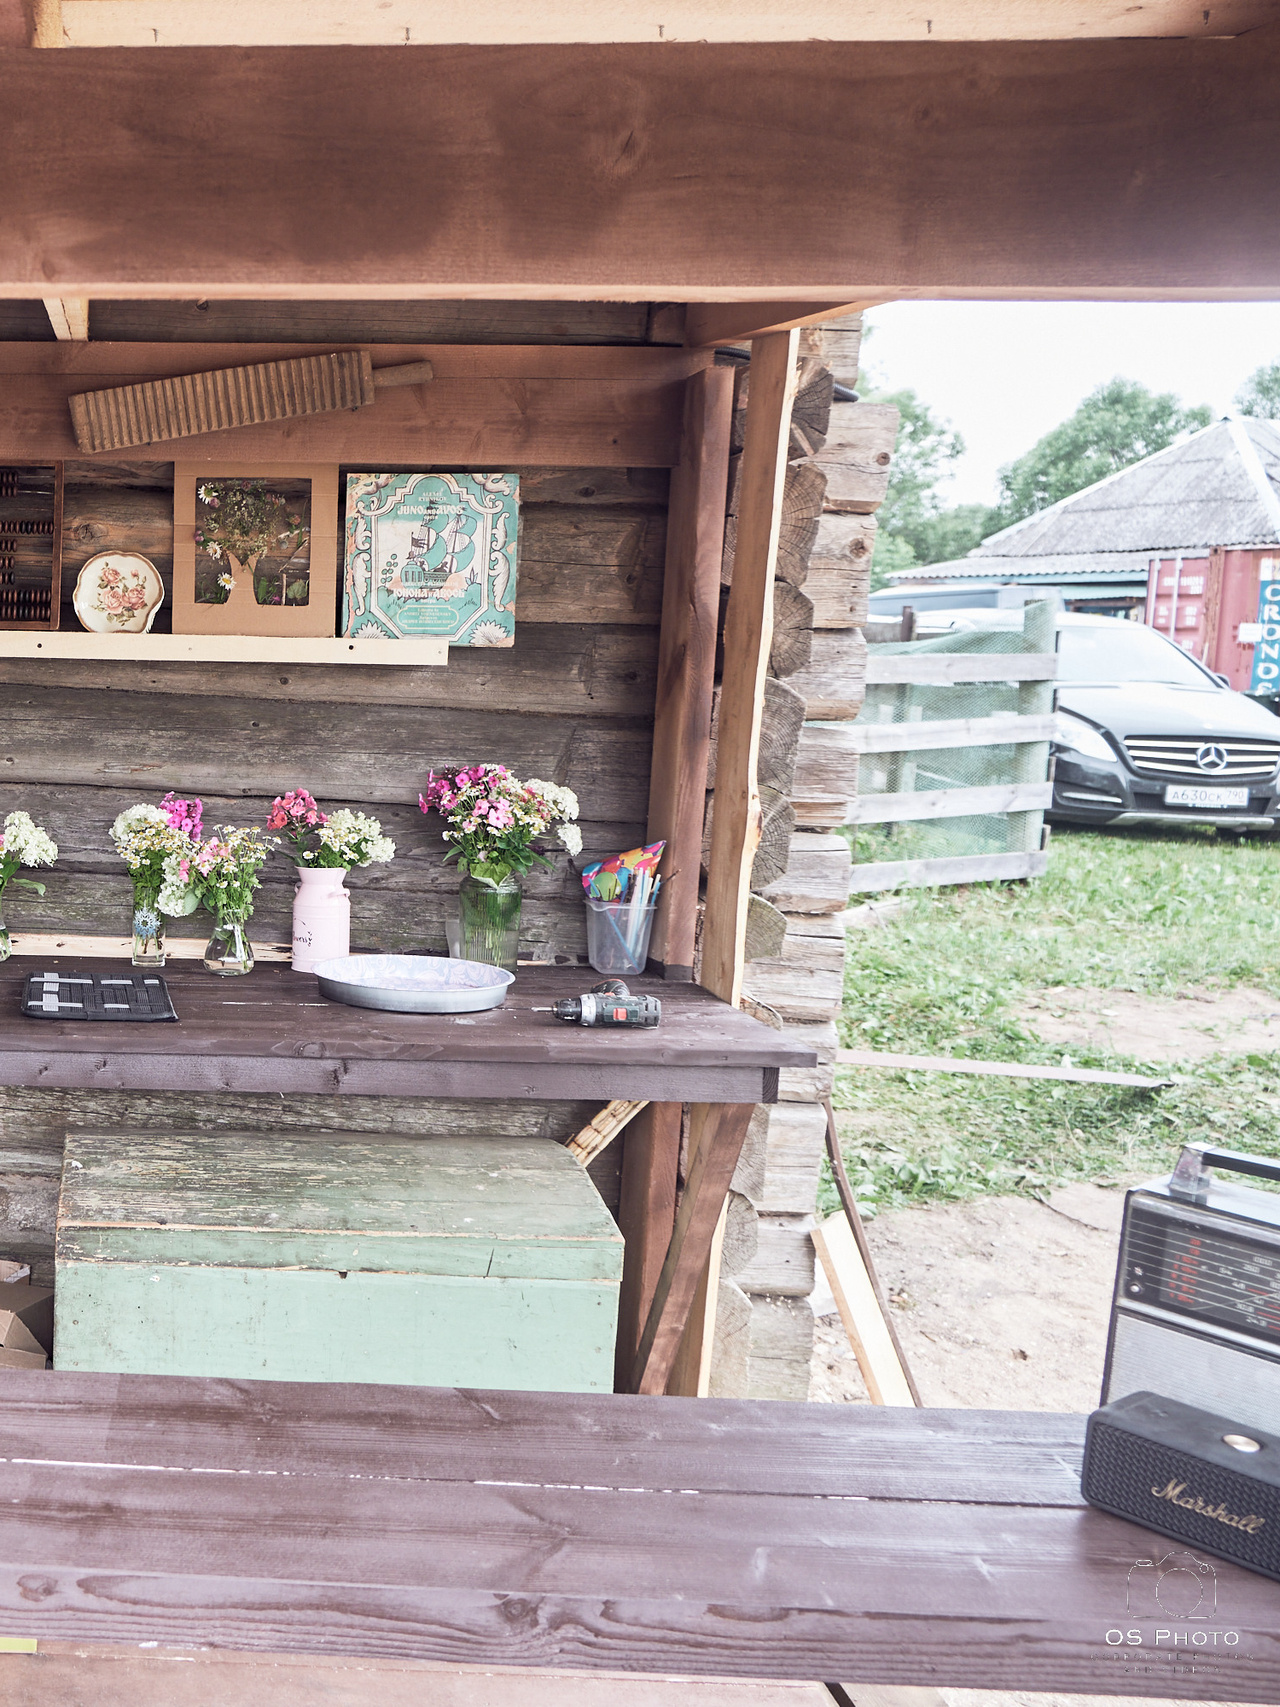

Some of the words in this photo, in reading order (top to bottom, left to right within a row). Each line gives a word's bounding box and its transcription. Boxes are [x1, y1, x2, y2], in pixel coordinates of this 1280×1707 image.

[398, 505, 424, 514] JUNO
[436, 505, 464, 514] AVOS
[1151, 1478, 1266, 1534] Marshall
